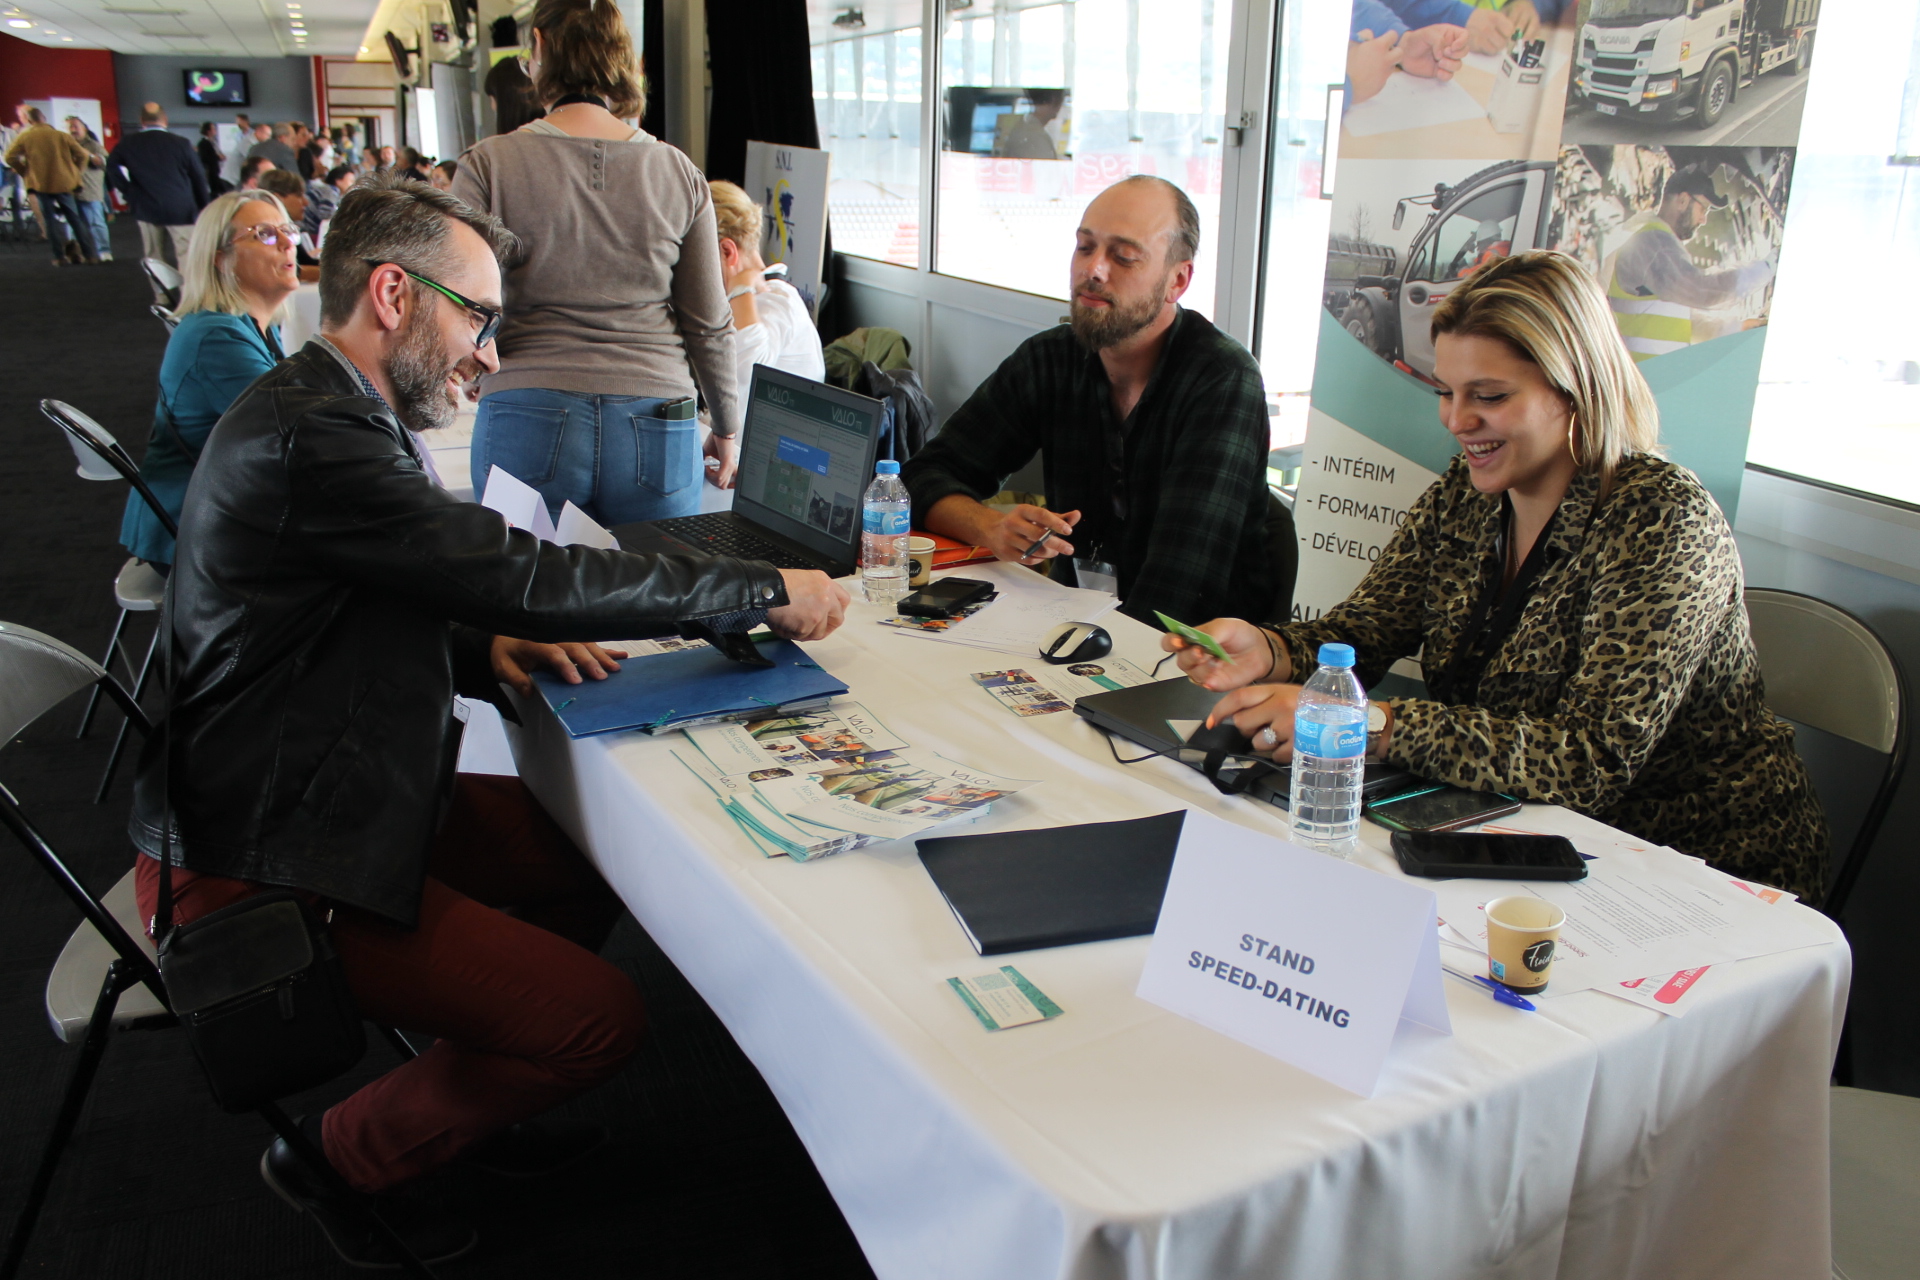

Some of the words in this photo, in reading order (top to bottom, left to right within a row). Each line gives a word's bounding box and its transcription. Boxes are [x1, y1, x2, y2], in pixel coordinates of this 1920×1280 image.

[1600, 35, 1631, 45] SCANIA
[767, 384, 790, 405] VALO
[831, 405, 856, 426] VALO
[1323, 455, 1395, 484] INTÉRIM
[847, 714, 874, 735] VALO
[951, 769, 990, 786] VALO
[1239, 933, 1315, 975] STAND
[1188, 951, 1350, 1028] SPEED-DATING
